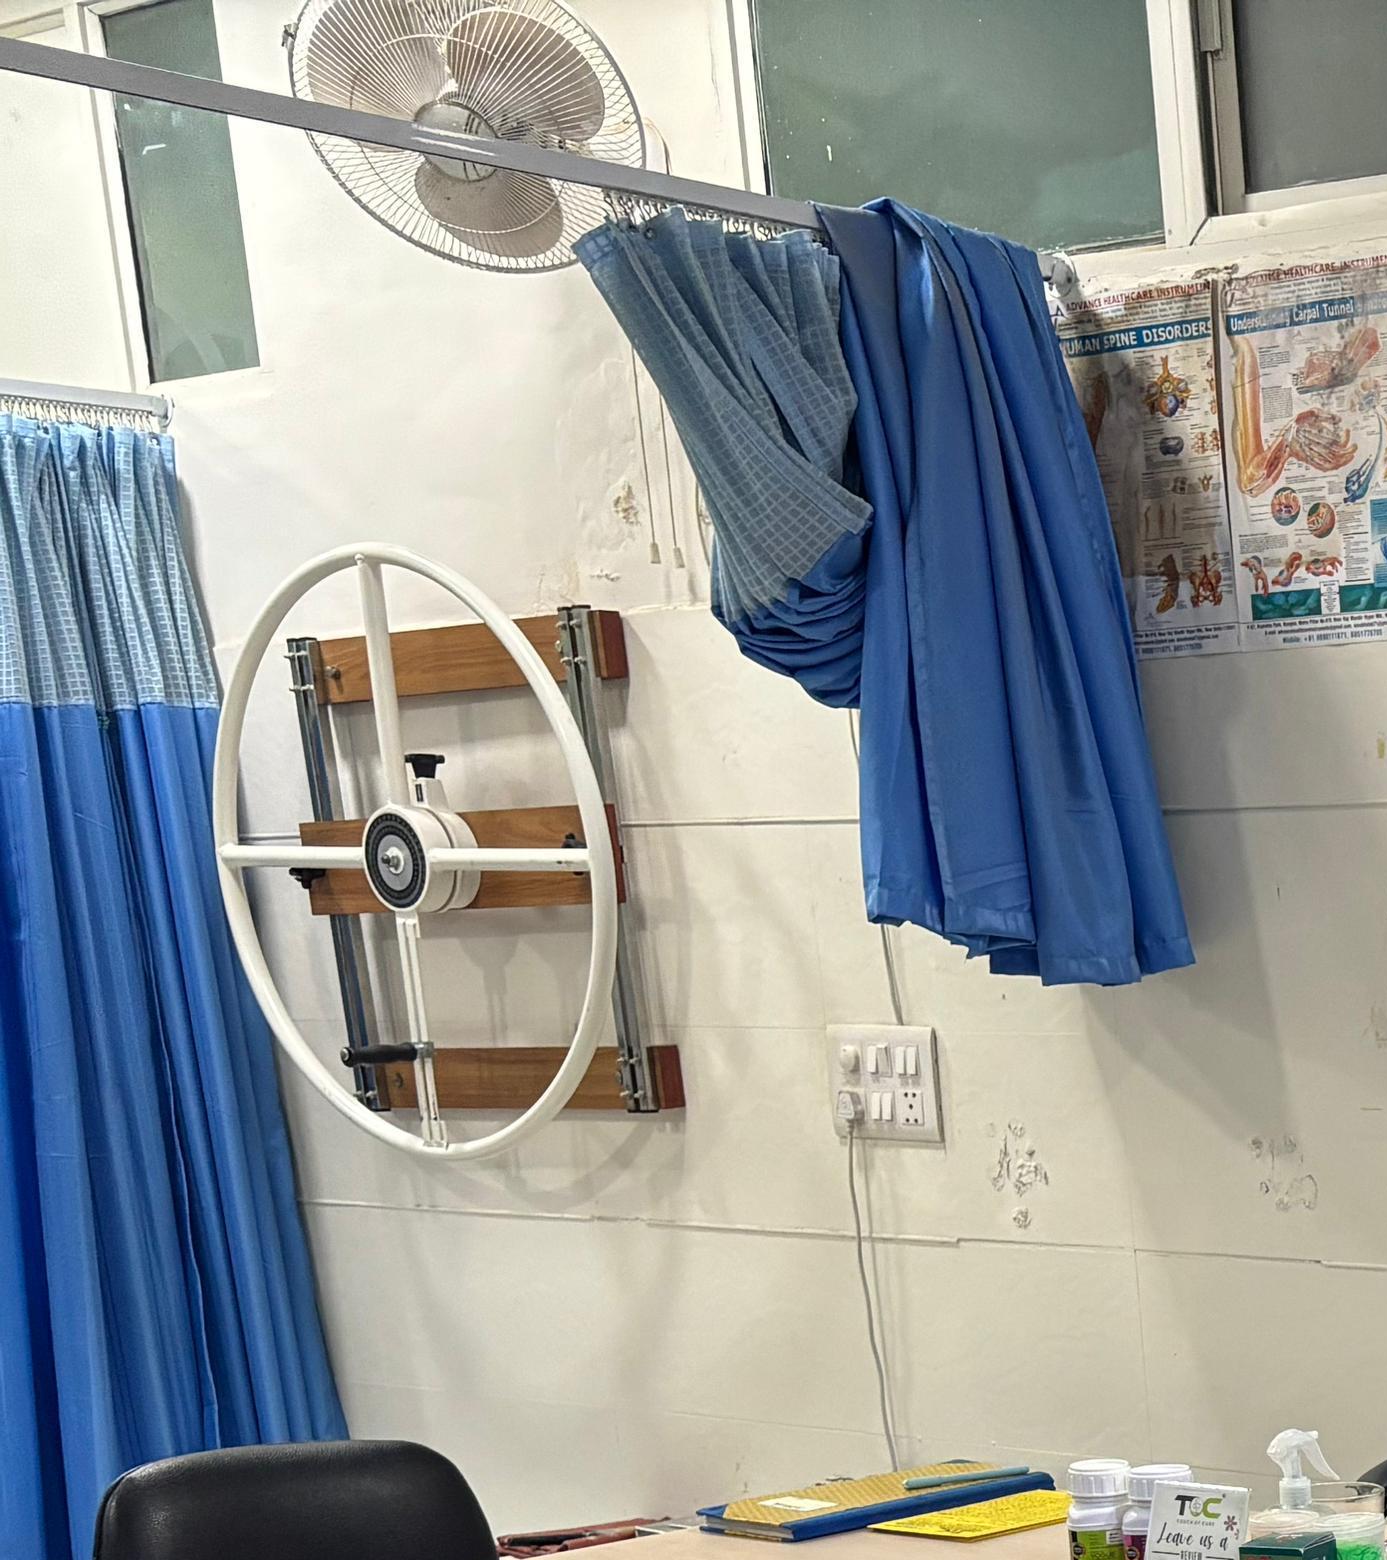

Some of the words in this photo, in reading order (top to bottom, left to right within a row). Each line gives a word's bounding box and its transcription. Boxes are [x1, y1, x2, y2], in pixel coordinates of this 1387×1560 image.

[1104, 290, 1153, 308] HEALTHCARE
[1293, 305, 1320, 322] Carpal
[1322, 297, 1354, 318] Tunnel
[1104, 332, 1137, 348] SPINE
[1142, 321, 1212, 343] DISORDERS
[1175, 1495, 1222, 1519] TOC
[1157, 1522, 1192, 1546] Leave
[1200, 1536, 1213, 1550] us
[1220, 1536, 1228, 1551] a
[1180, 1551, 1202, 1560] REVIEW
